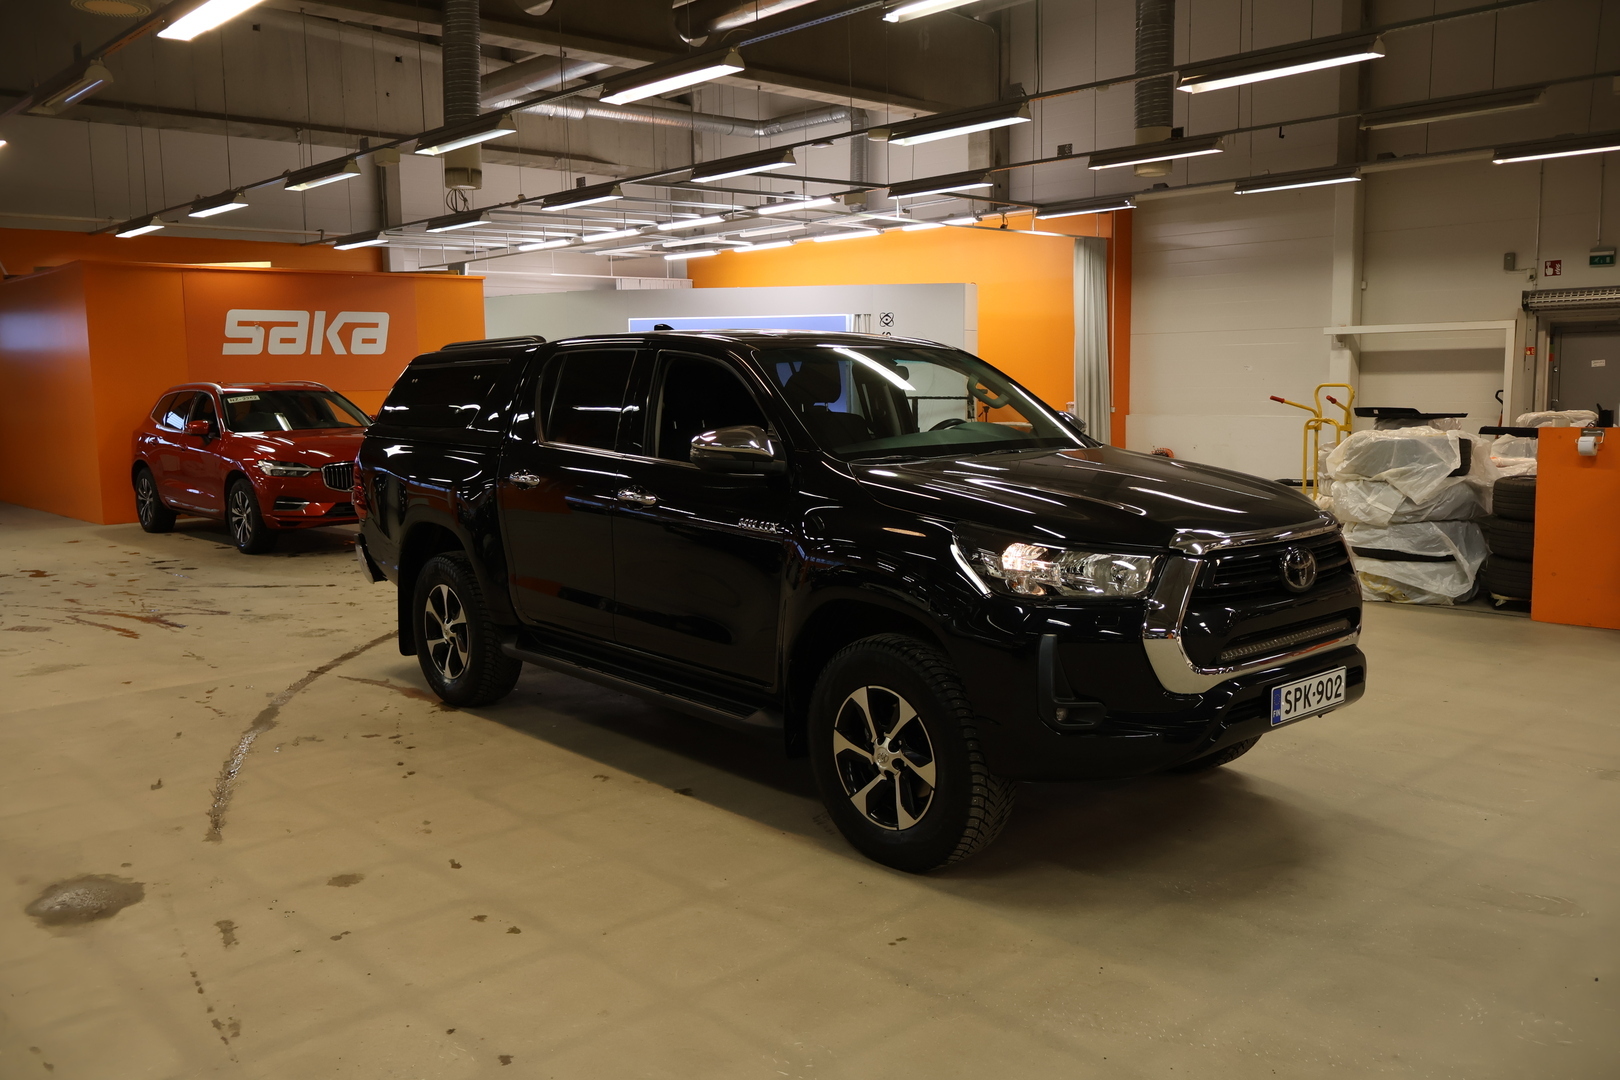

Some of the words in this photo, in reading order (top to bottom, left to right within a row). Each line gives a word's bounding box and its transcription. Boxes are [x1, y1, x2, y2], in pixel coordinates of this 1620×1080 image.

[738, 517, 780, 535] HILUX
[1284, 674, 1342, 715] SPK-902
[1273, 708, 1281, 718] FIN
